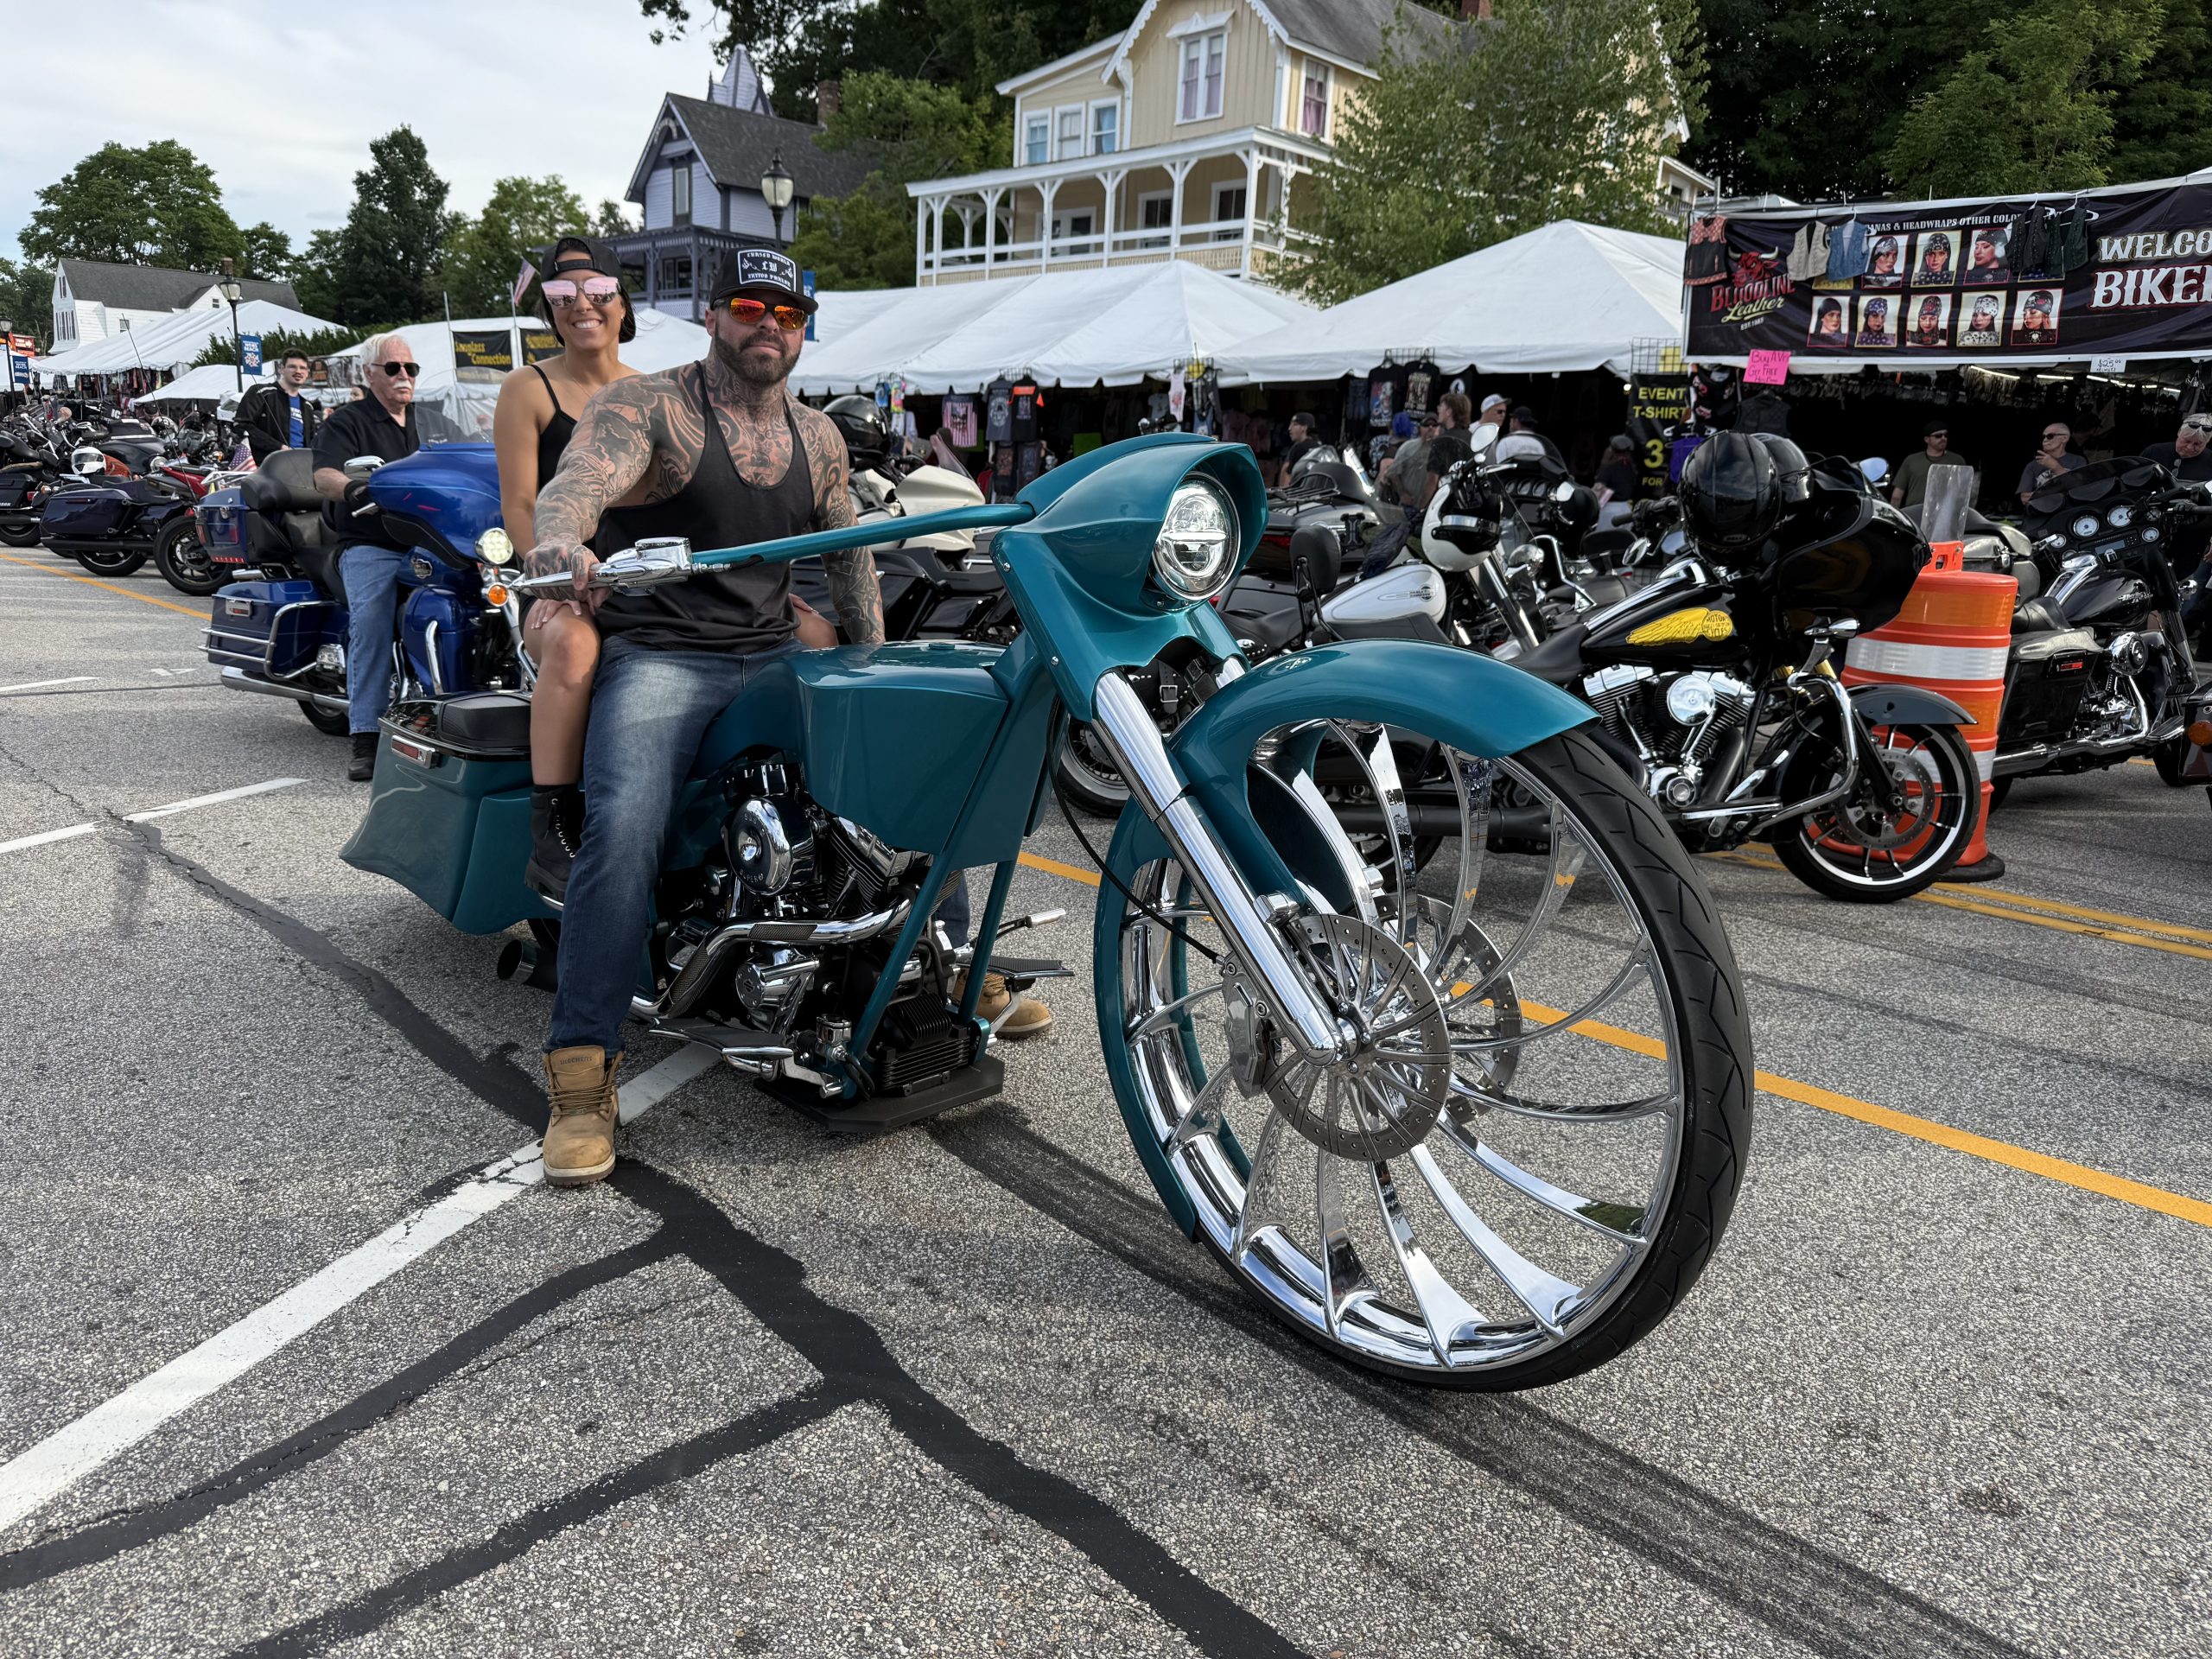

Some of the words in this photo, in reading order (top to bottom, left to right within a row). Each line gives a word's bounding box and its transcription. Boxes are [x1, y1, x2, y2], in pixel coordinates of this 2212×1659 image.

[1893, 222, 1901, 231] &
[1903, 219, 1957, 231] HEADWRAPS
[1959, 216, 1991, 226] OTHER
[1711, 272, 1796, 312] BLOODLINE
[1721, 296, 1784, 322] Leather
[472, 353, 512, 365] Connection
[1638, 387, 1686, 400] EVENT
[1643, 439, 1664, 468] 3
[1642, 477, 1663, 486] FOR
